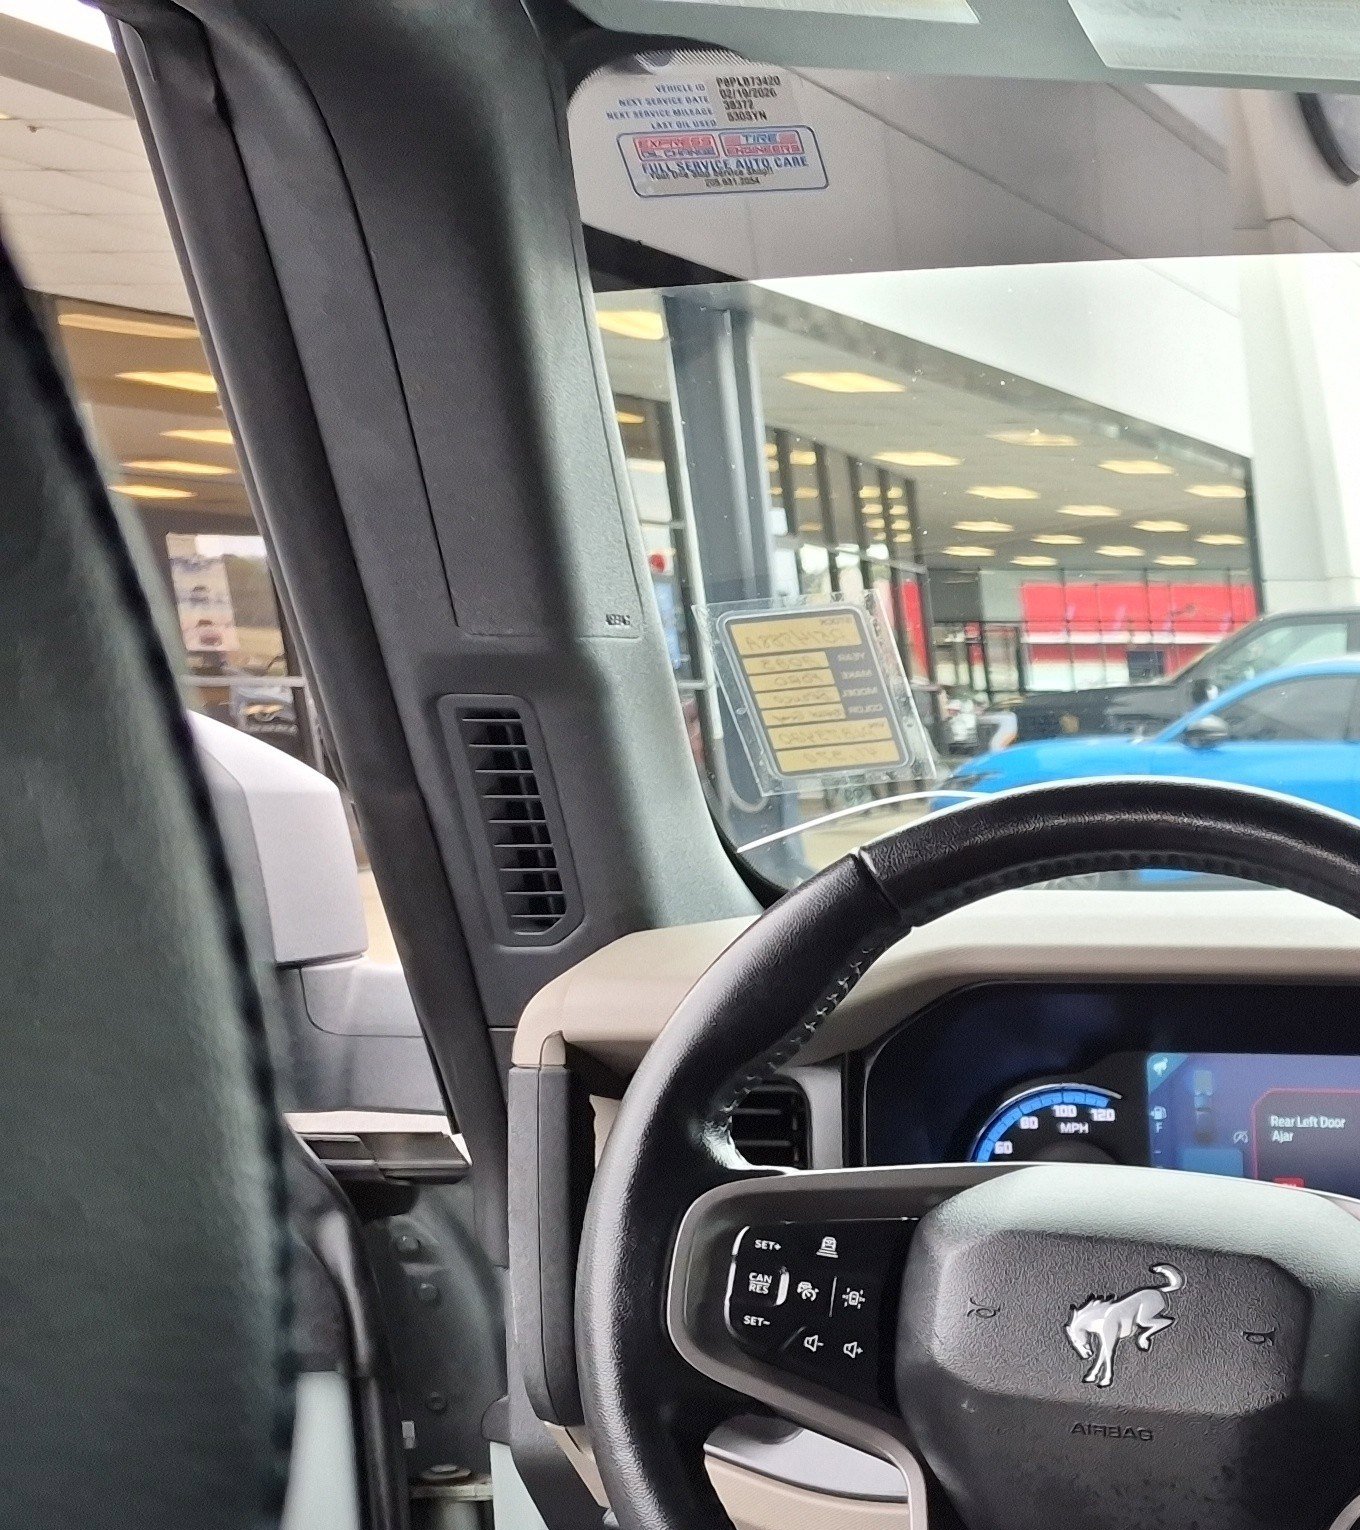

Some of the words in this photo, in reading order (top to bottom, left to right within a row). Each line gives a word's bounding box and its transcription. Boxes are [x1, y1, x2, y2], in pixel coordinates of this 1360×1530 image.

[655, 84, 693, 93] VEHICLE
[619, 98, 642, 107] NEXT
[645, 97, 682, 106] SERVICE
[685, 96, 708, 104] DATE
[606, 111, 630, 120] NEXT
[633, 109, 670, 118] SERVICE
[672, 108, 713, 116] MILEAGE
[693, 119, 717, 128] USED
[642, 162, 671, 174] FULL
[678, 159, 729, 172] SERVICE
[735, 157, 770, 170] AUTO
[775, 155, 810, 168] CARE
[1052, 1105, 1077, 1118] 100
[1090, 1108, 1115, 1122] 120
[1060, 1122, 1089, 1135] MPH
[1155, 1123, 1163, 1133] F
[1270, 1116, 1296, 1128] Rear
[1298, 1116, 1319, 1128] Left
[1320, 1117, 1345, 1129] Door
[1272, 1130, 1294, 1144] Ajar
[749, 1272, 773, 1284] CAN
[749, 1284, 769, 1295] RES
[1070, 1422, 1153, 1441] AIRBAG
